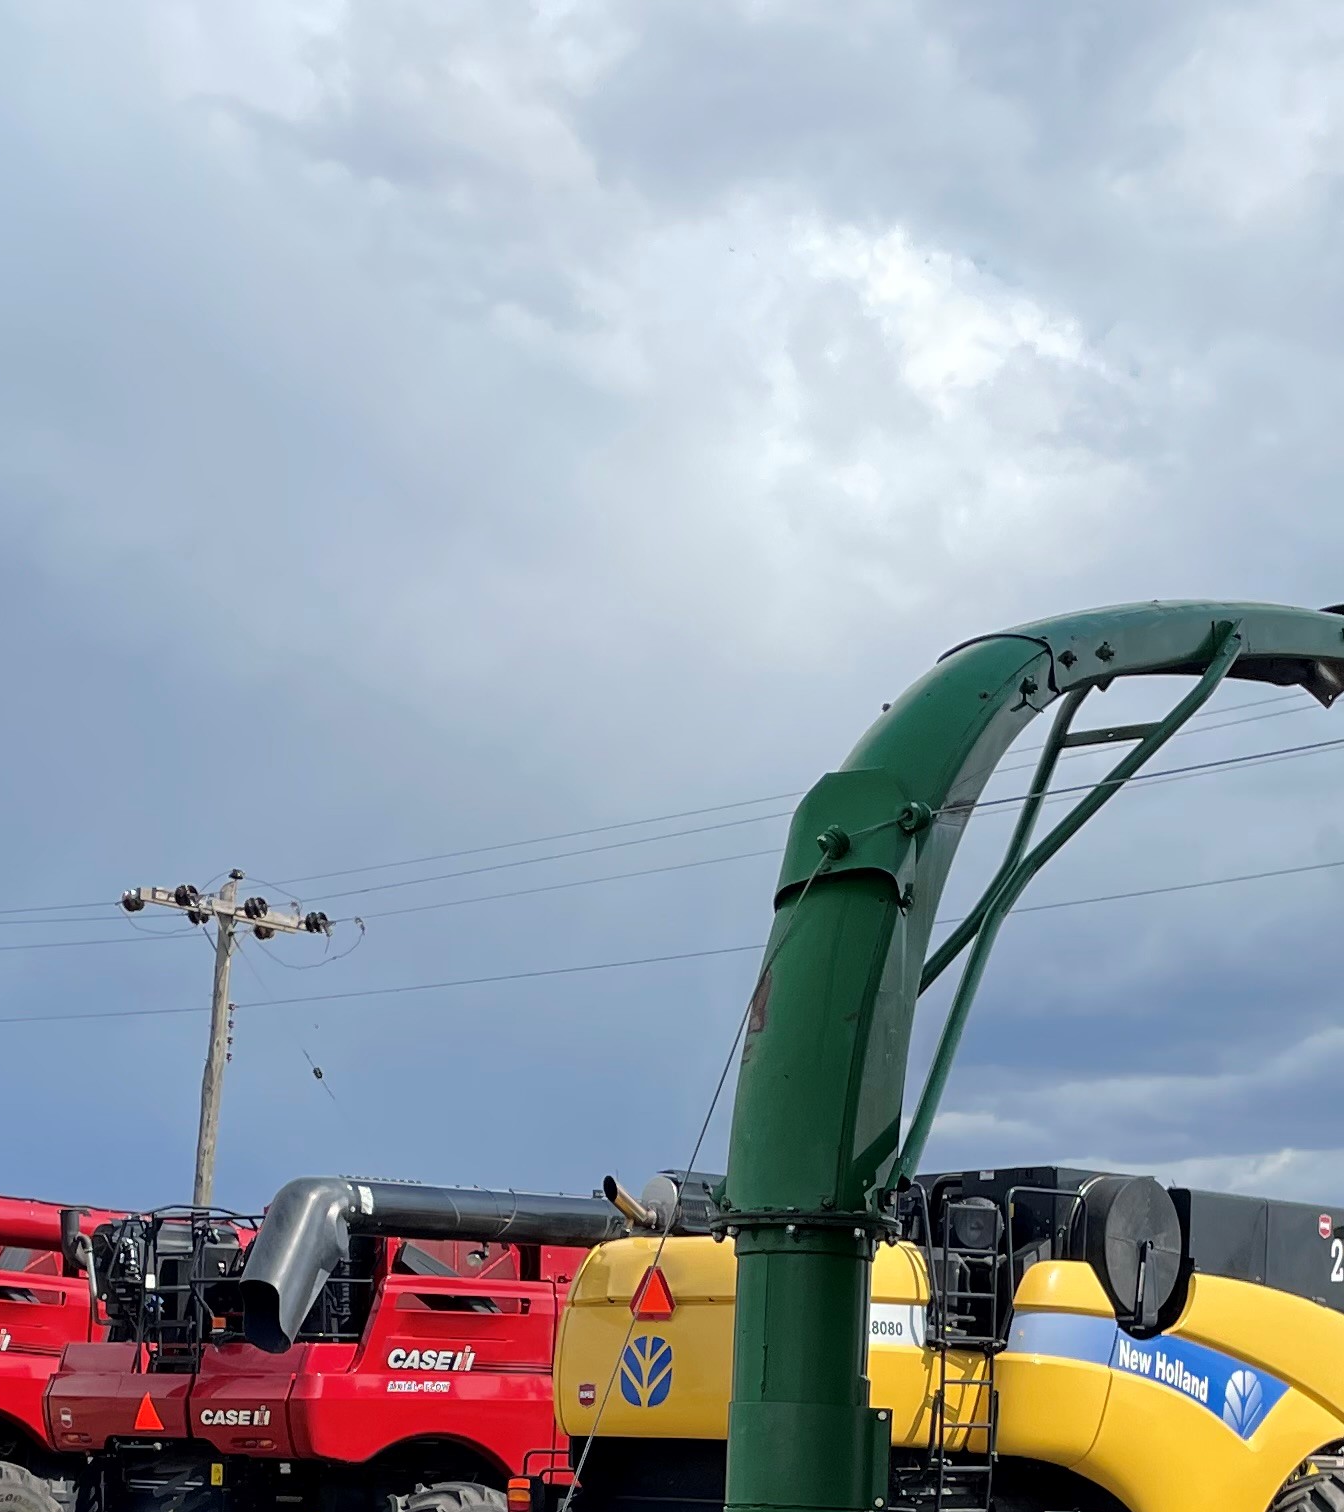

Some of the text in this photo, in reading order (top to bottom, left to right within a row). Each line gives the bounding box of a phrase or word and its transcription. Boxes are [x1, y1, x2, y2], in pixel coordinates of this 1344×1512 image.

[1330, 1238, 1344, 1282] 2
[868, 1320, 903, 1336] 8080
[387, 1348, 453, 1371] CASE
[1118, 1339, 1209, 1403] New Holland
[200, 1409, 251, 1425] CASE
